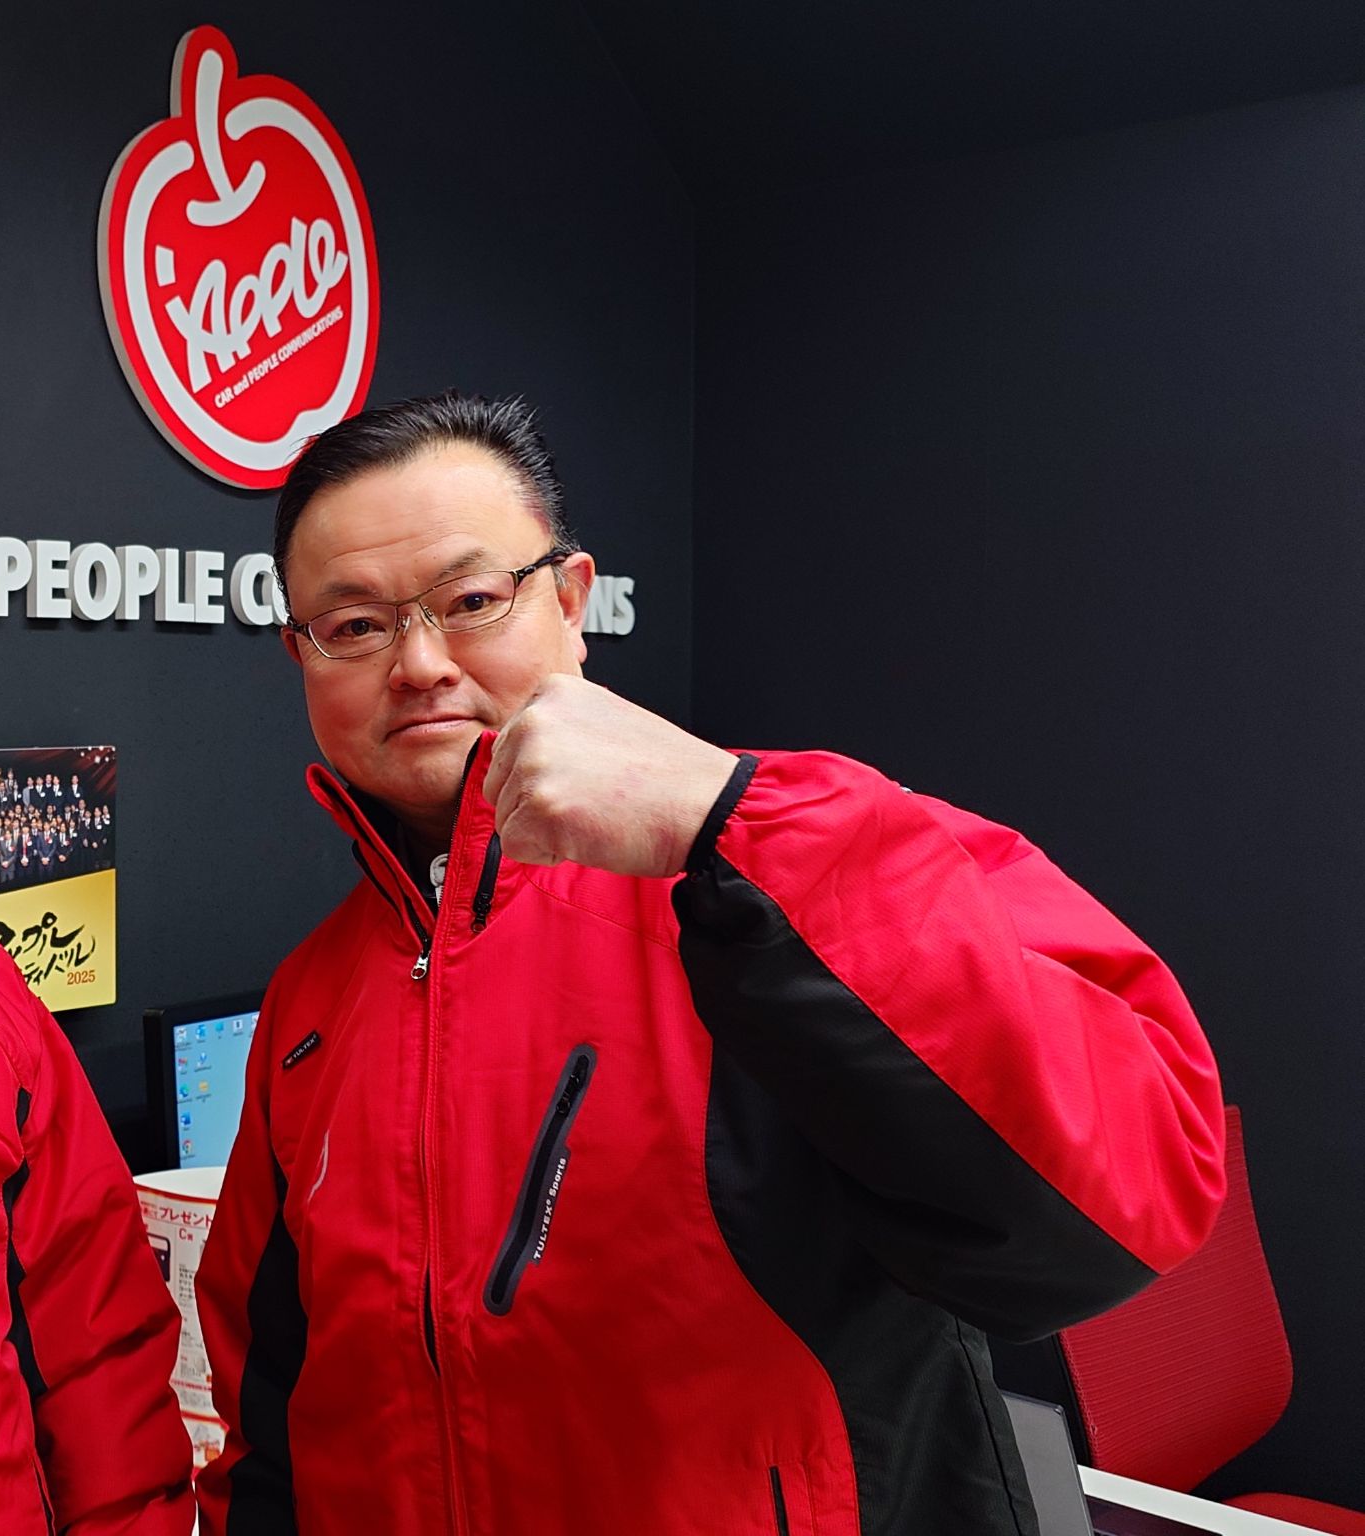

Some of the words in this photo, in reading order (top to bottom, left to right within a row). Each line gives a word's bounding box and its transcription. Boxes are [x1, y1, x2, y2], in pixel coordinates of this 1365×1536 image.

[215, 387, 235, 408] CAR
[233, 375, 250, 396] and
[247, 353, 280, 384] PEOPLE
[66, 969, 96, 986] 2025
[548, 1157, 567, 1198] Sports
